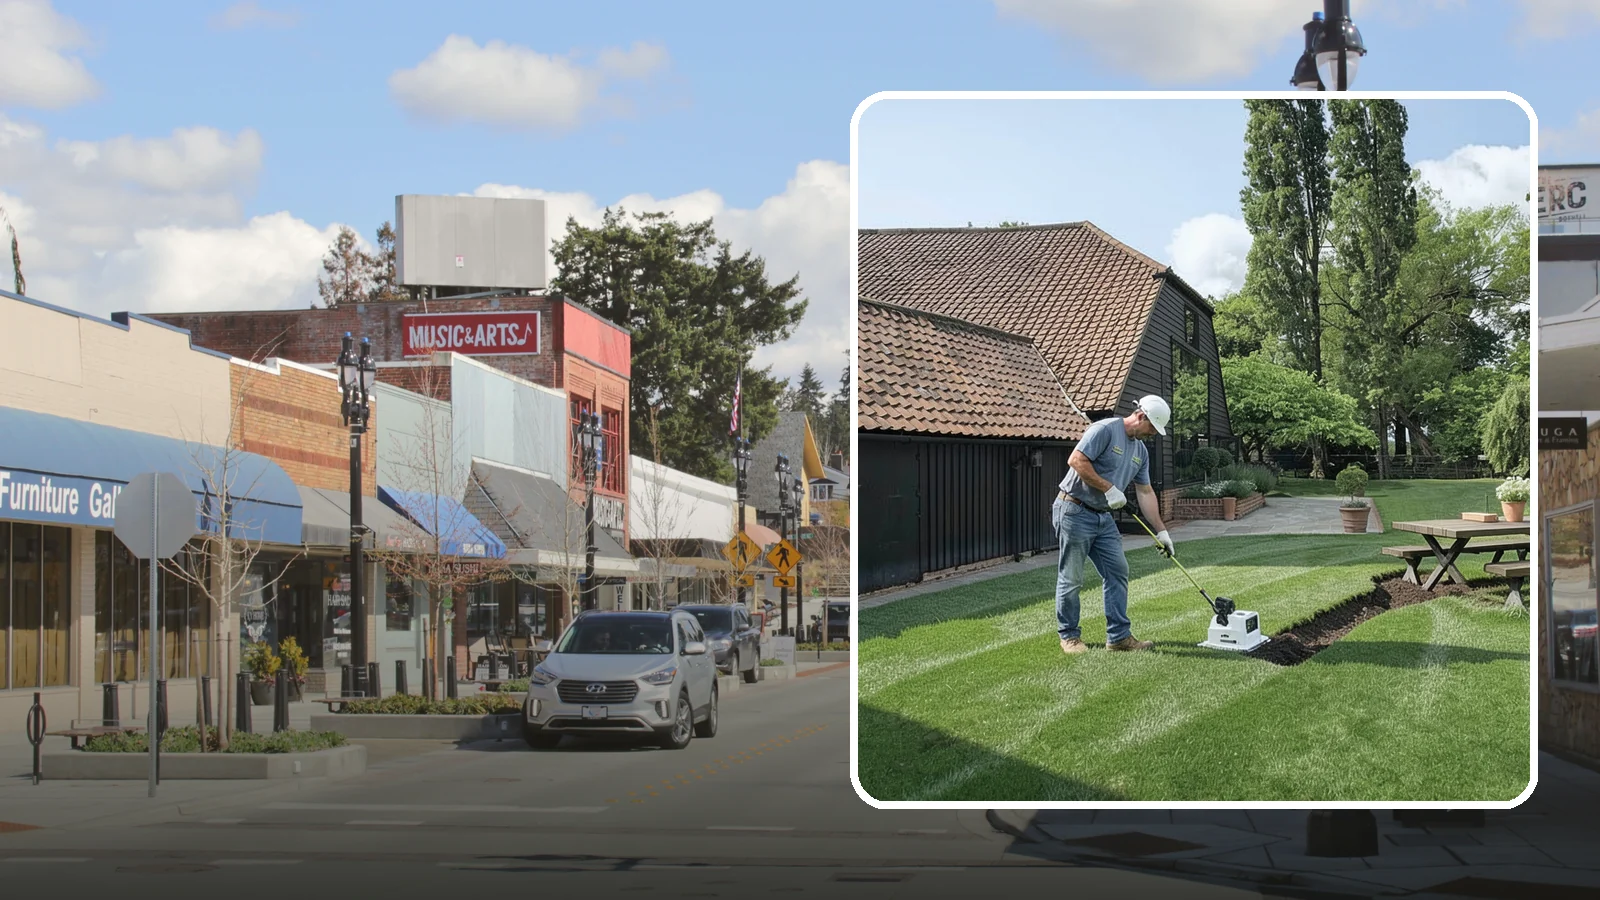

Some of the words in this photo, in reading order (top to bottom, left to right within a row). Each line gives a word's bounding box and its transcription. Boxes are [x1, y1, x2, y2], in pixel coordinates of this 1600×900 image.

[409, 323, 519, 348] MUSIC&ARTS
[0, 471, 79, 515] Furniture
[90, 482, 121, 519] Gal
[453, 563, 479, 575] SUSHI
